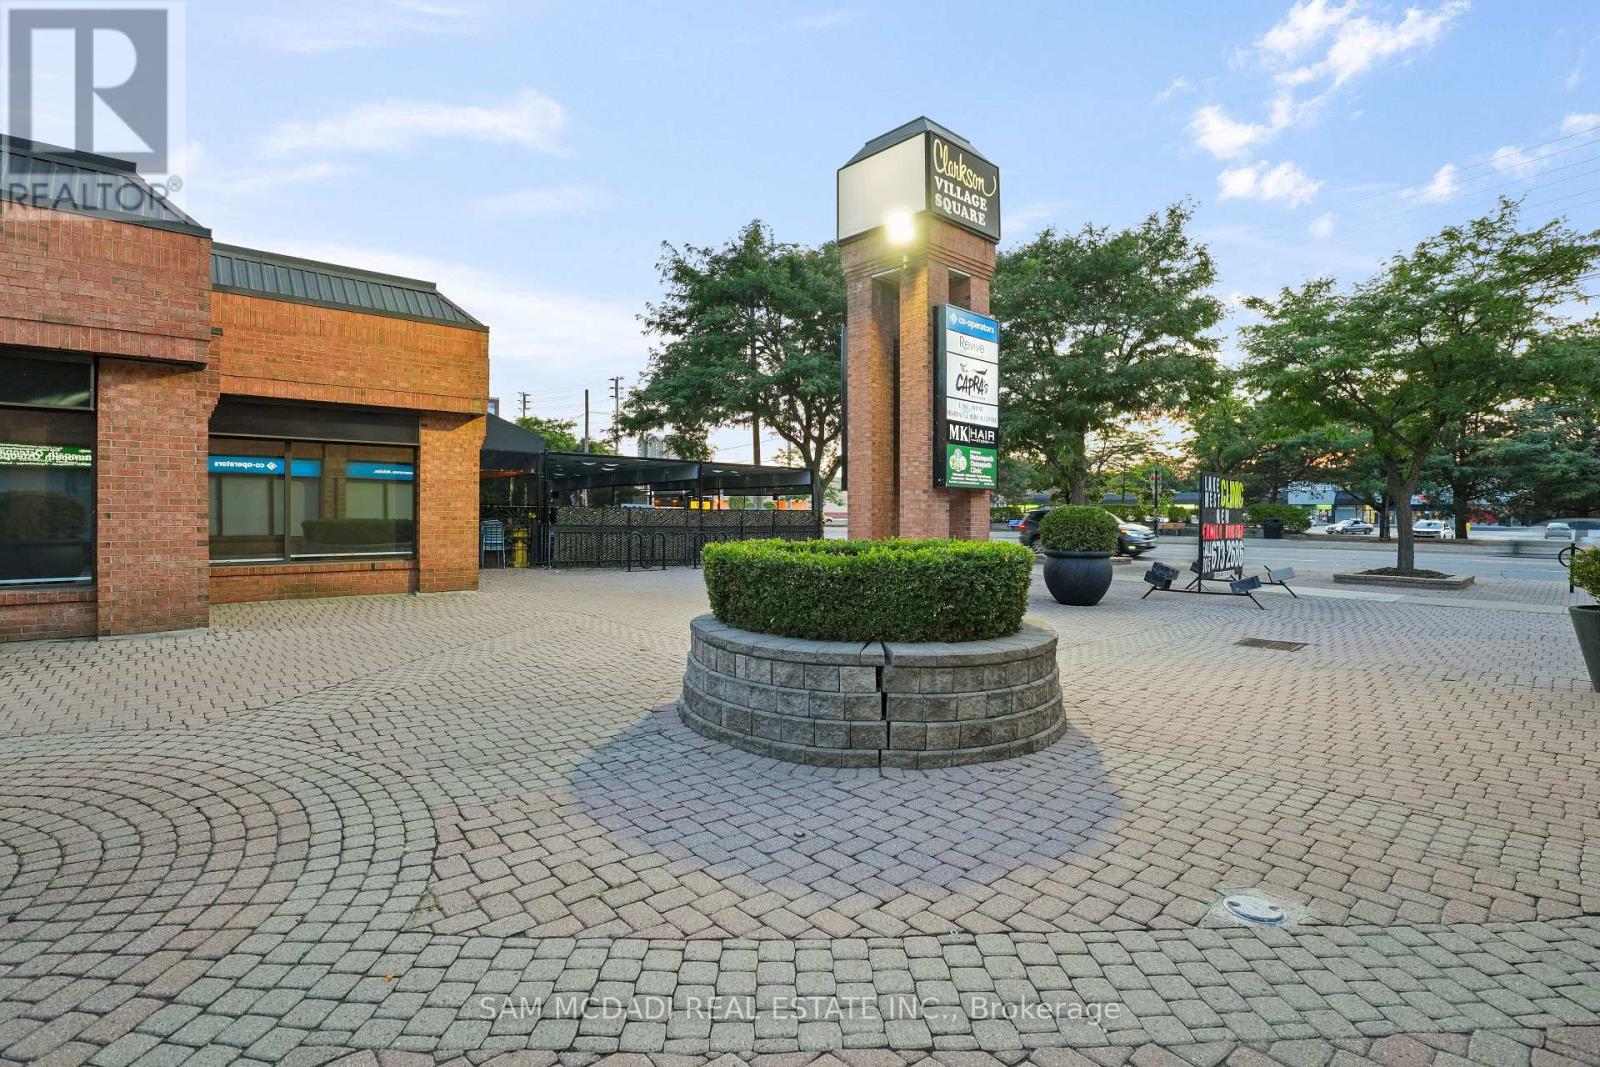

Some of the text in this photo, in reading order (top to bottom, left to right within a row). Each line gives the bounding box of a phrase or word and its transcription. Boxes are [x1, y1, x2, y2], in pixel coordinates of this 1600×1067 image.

[934, 139, 996, 196] Clarkson
[934, 175, 988, 212] VILLAGE
[934, 193, 987, 226] SQUARE
[958, 317, 995, 335] co-operators
[959, 335, 985, 354] Revive
[949, 423, 995, 442] MK HAIR
[1204, 475, 1220, 493] LAKE
[1204, 492, 1220, 508] WEST
